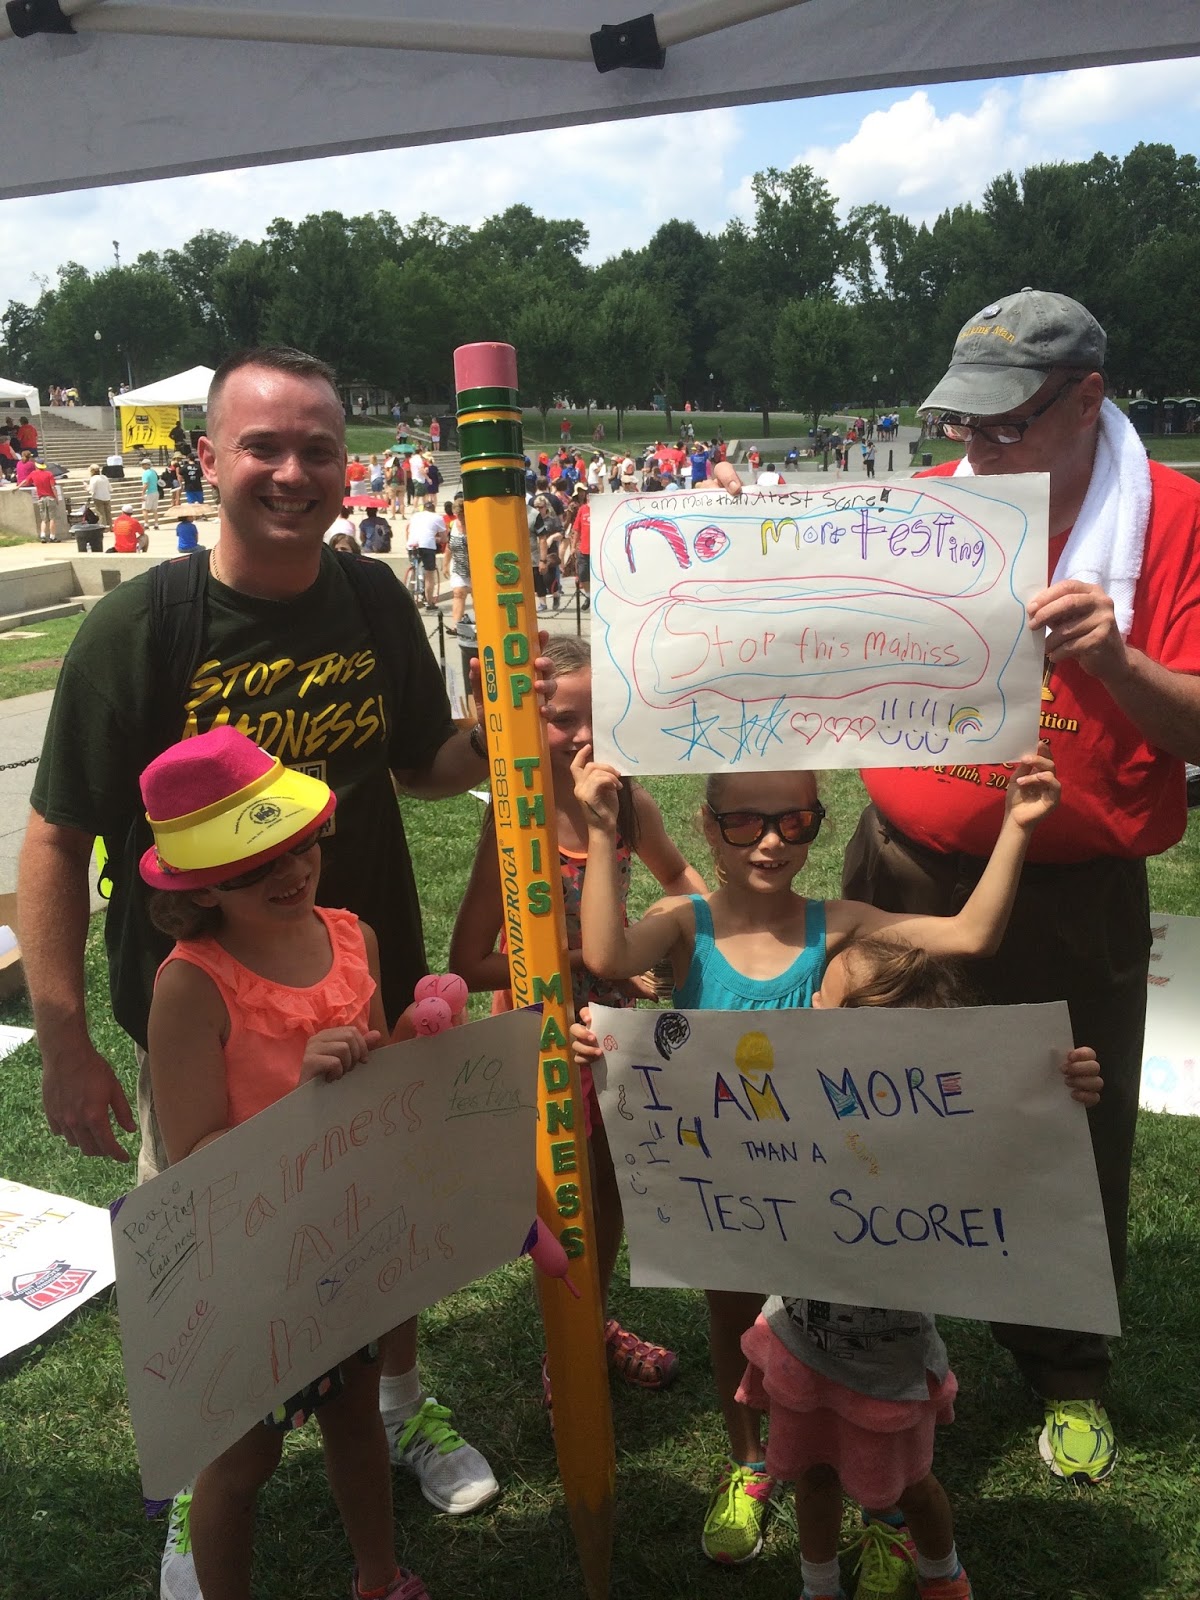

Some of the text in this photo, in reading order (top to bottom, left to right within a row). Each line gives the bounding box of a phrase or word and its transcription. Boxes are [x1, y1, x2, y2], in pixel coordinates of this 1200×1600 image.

[992, 325, 1016, 343] Man
[636, 497, 645, 514] I
[651, 497, 677, 511] am
[716, 491, 749, 507] than
[184, 649, 376, 711] STOP THIS
[485, 656, 496, 694] SOFT
[1040, 711, 1078, 732] ition
[490, 713, 513, 829] 1388-2
[949, 765, 981, 784] 10th,
[494, 551, 585, 1260] STOP THIS MADNESS
[631, 1065, 975, 1122] I AM MORE
[743, 1140, 798, 1163] THAN
[811, 1142, 827, 1164] A
[680, 1177, 1011, 1257] TEST SCORE!
